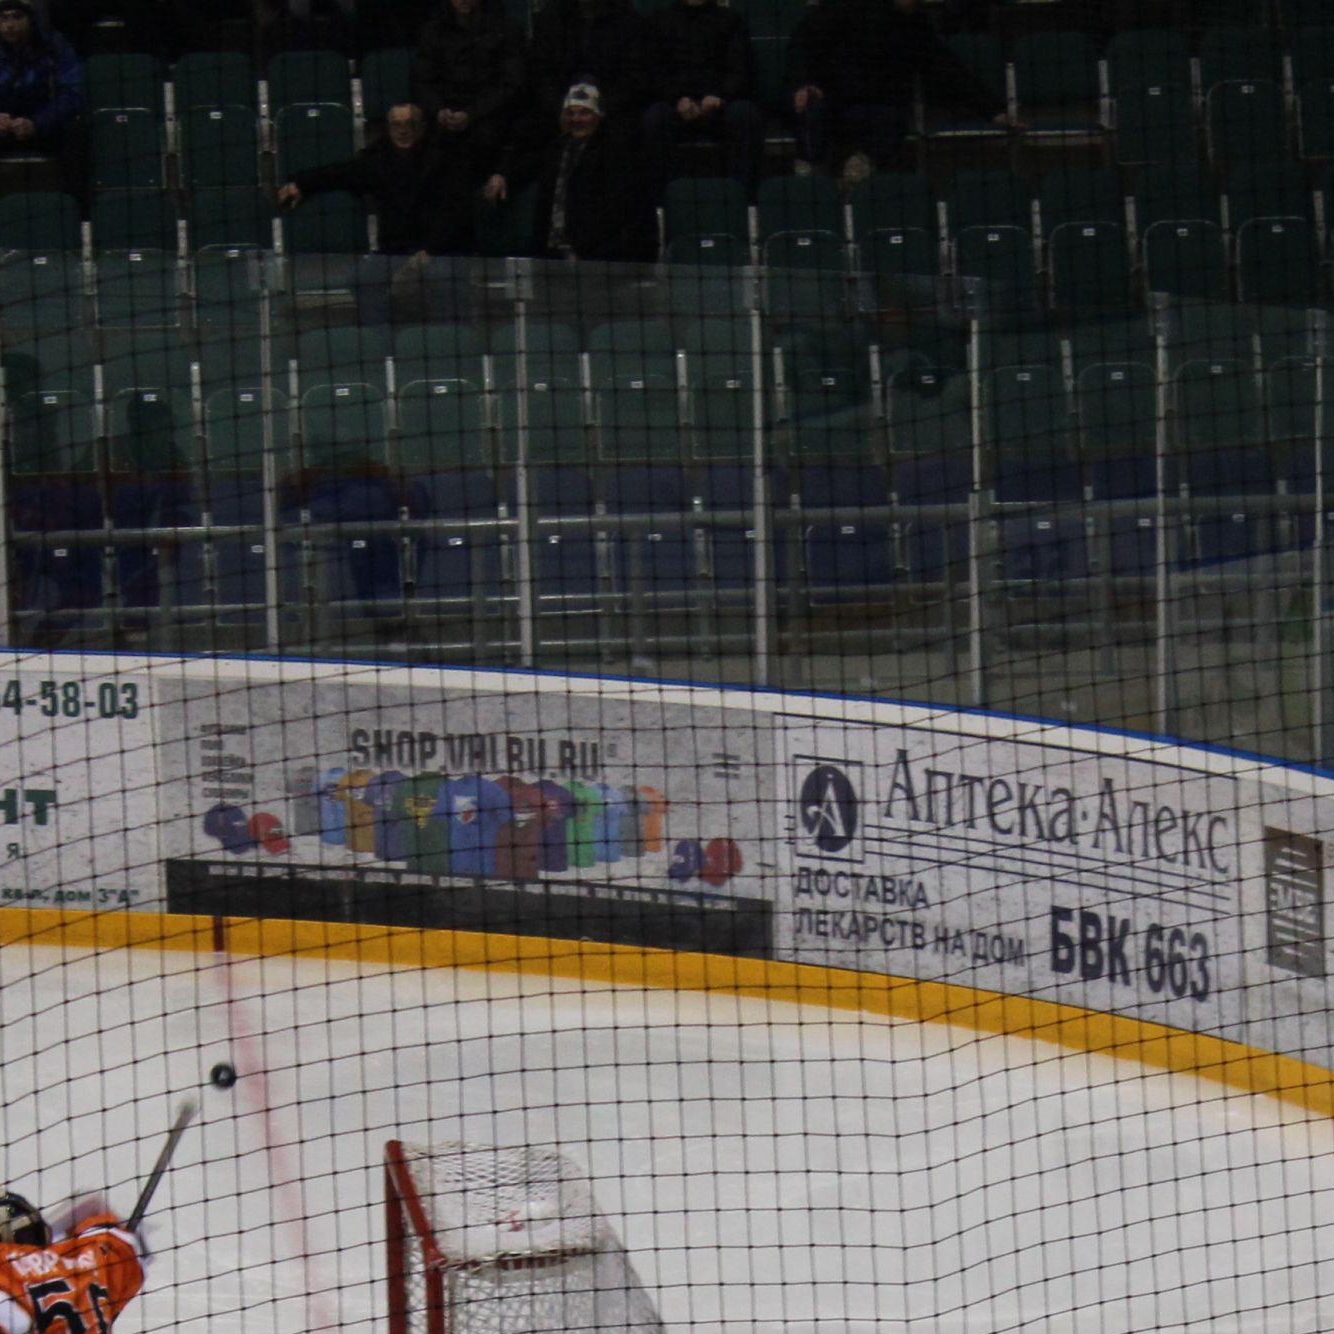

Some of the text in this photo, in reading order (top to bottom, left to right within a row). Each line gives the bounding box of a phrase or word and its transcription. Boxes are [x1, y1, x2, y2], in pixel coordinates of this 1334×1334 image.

[795, 866, 930, 908] ДОСТАВКА
[794, 907, 1025, 967] ЛЕКАРСТВ НА ДОМ
[1051, 905, 1211, 1002] БВК 663
